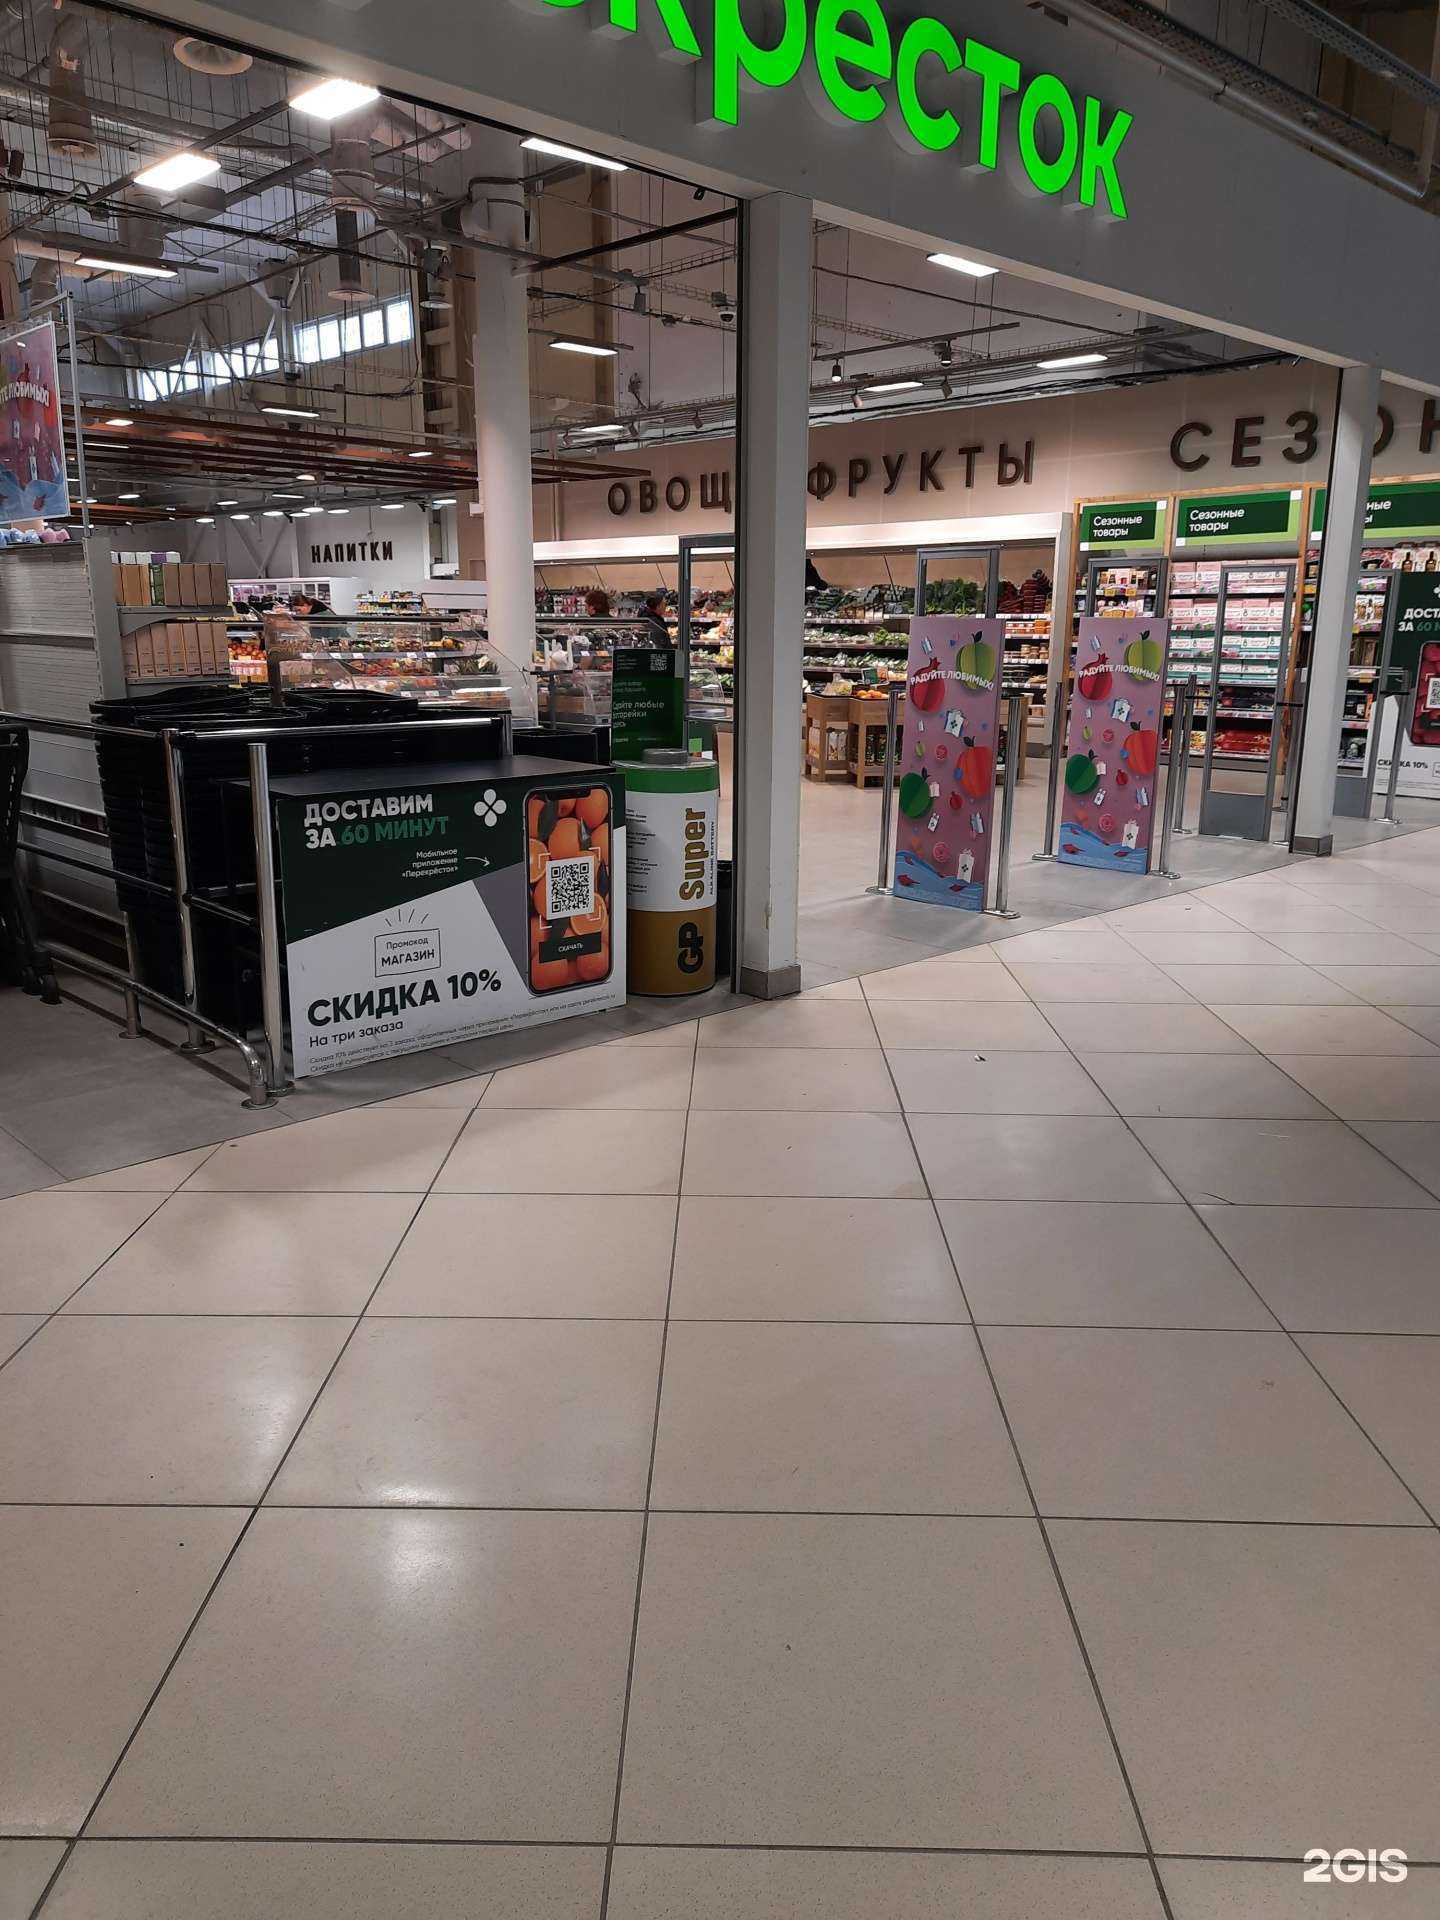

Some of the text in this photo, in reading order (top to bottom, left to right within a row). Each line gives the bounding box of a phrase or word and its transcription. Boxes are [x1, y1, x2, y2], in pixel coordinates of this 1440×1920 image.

[541, 0, 1133, 219] ресток
[607, 440, 1034, 516] ОВОЩ ФРУКТЫ
[1093, 513, 1143, 527] Сезонные
[1189, 507, 1245, 521] Сезонные
[1093, 527, 1129, 539] товары
[1189, 520, 1229, 533] товары
[311, 540, 393, 563] НАПИТКИ
[1398, 621, 1414, 632] ЗА
[1416, 621, 1432, 632] 60
[910, 669, 994, 691] РАДУЙТЕ ЛЮБИМЫХ!
[1078, 663, 1160, 682] РАДУЙТЕ ЛЮБИМЫХ!
[304, 793, 433, 827] ДОСТАВИМ
[305, 815, 448, 849] ЗА 60 МИНУТ
[412, 857, 458, 869] приложение
[416, 848, 458, 859] Мобильное
[679, 808, 709, 900] Super
[386, 937, 429, 950] Промокод
[678, 922, 703, 974] GP
[381, 949, 435, 967] МАГАЗИН
[307, 969, 502, 1027] СКИДКА 10%
[309, 1020, 403, 1048] На три заказа
